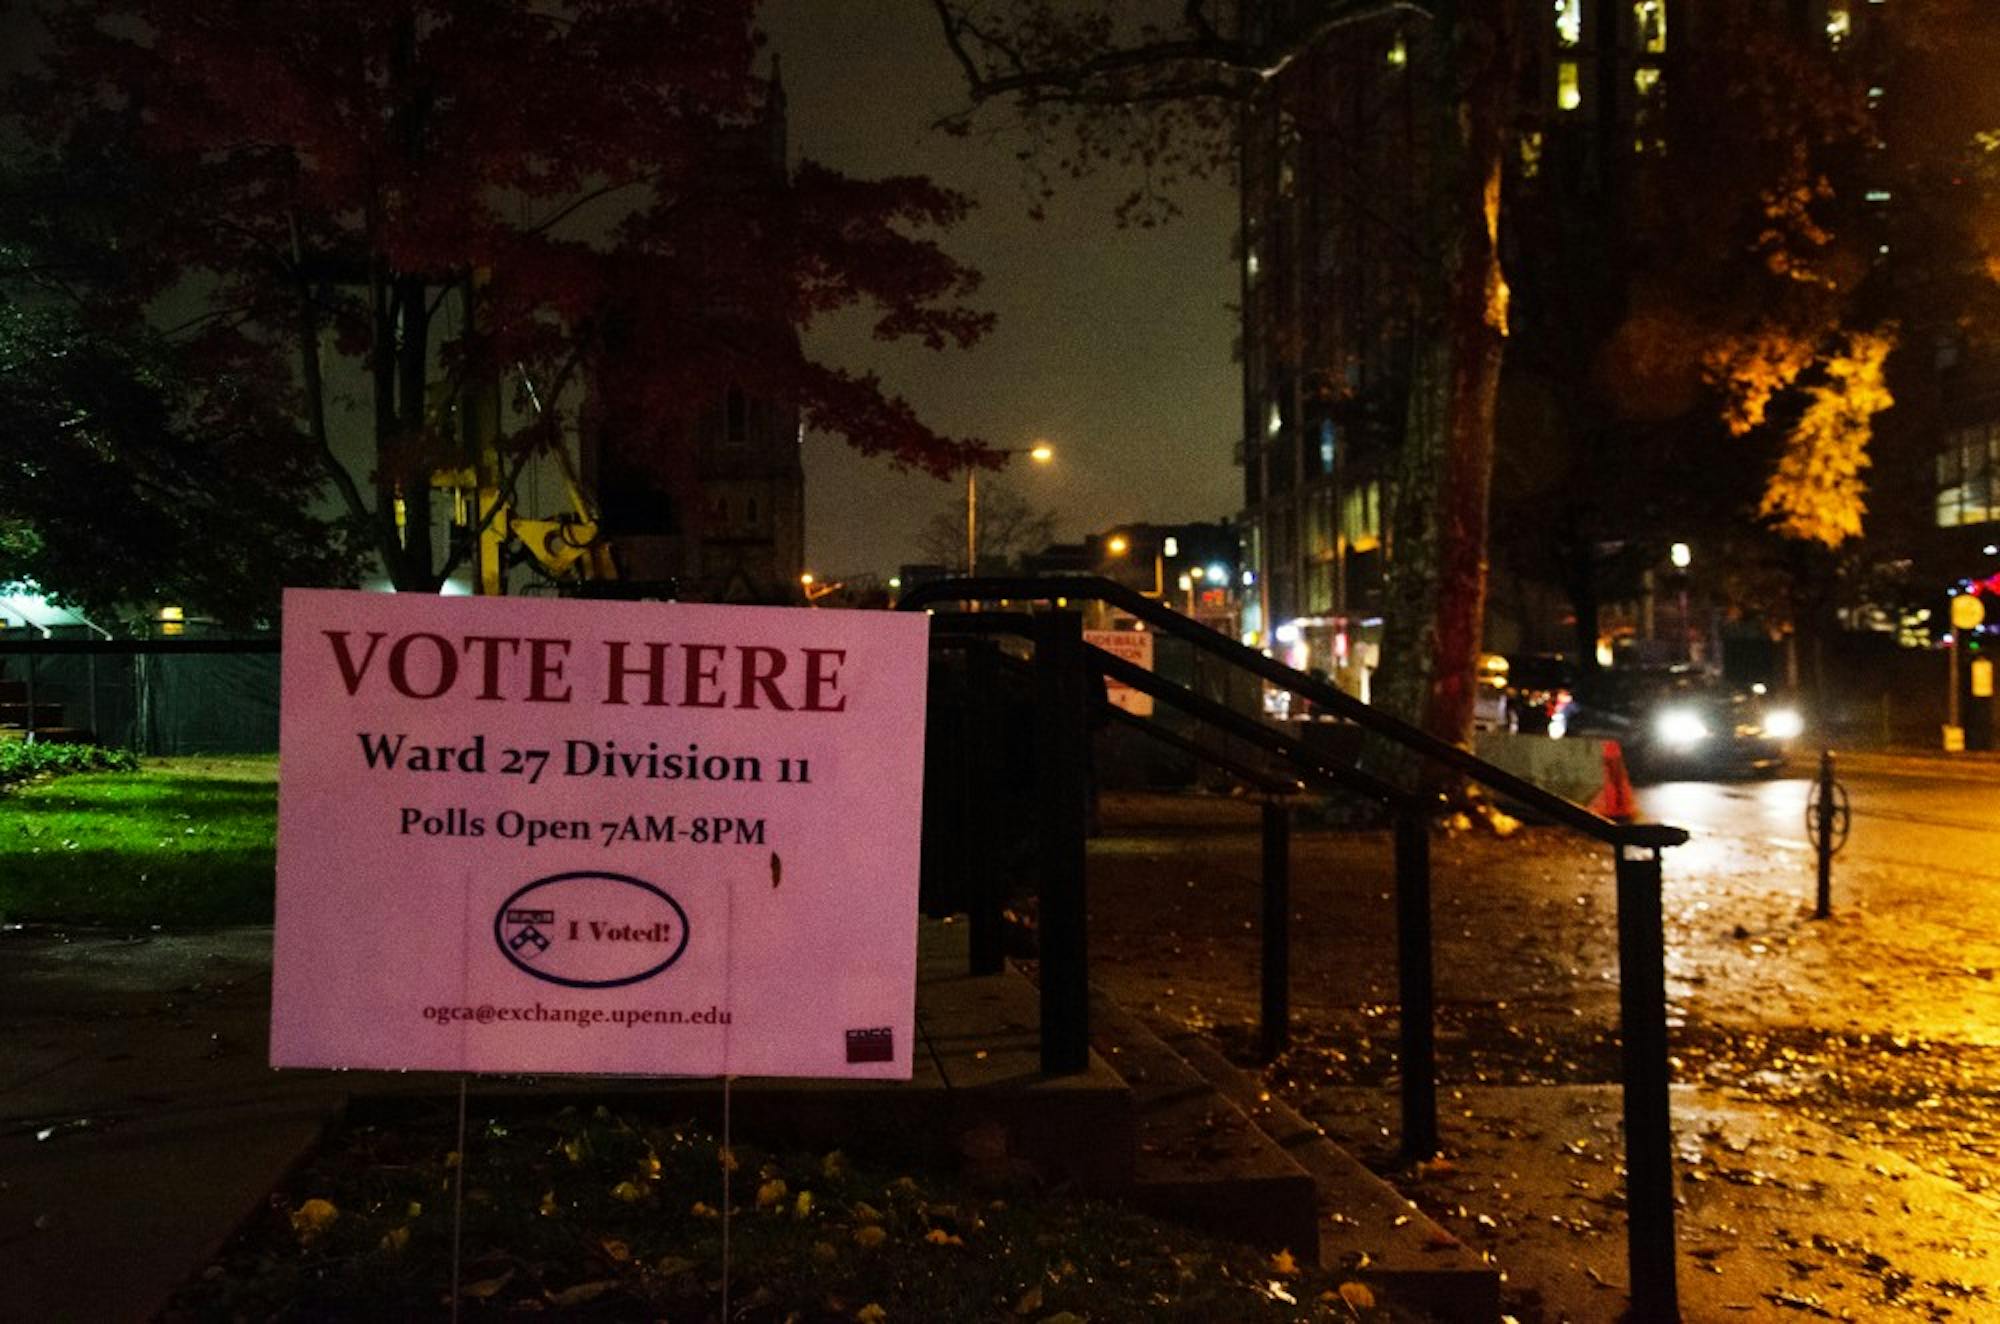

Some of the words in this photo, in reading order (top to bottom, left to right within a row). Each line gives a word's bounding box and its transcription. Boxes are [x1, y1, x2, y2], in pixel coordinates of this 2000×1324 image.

[321, 630, 572, 703] VOTE
[601, 640, 847, 713] HERE
[357, 733, 486, 774] Ward
[500, 748, 551, 785] 27
[564, 740, 761, 783] Division
[778, 758, 811, 784] 11
[400, 807, 486, 837] Polls
[495, 810, 591, 847] Open
[600, 815, 766, 848] 7AM-8PM
[568, 921, 579, 941] I
[588, 921, 671, 943] Voted!
[422, 1002, 733, 1029] ogca@exchange.upenn.edu
